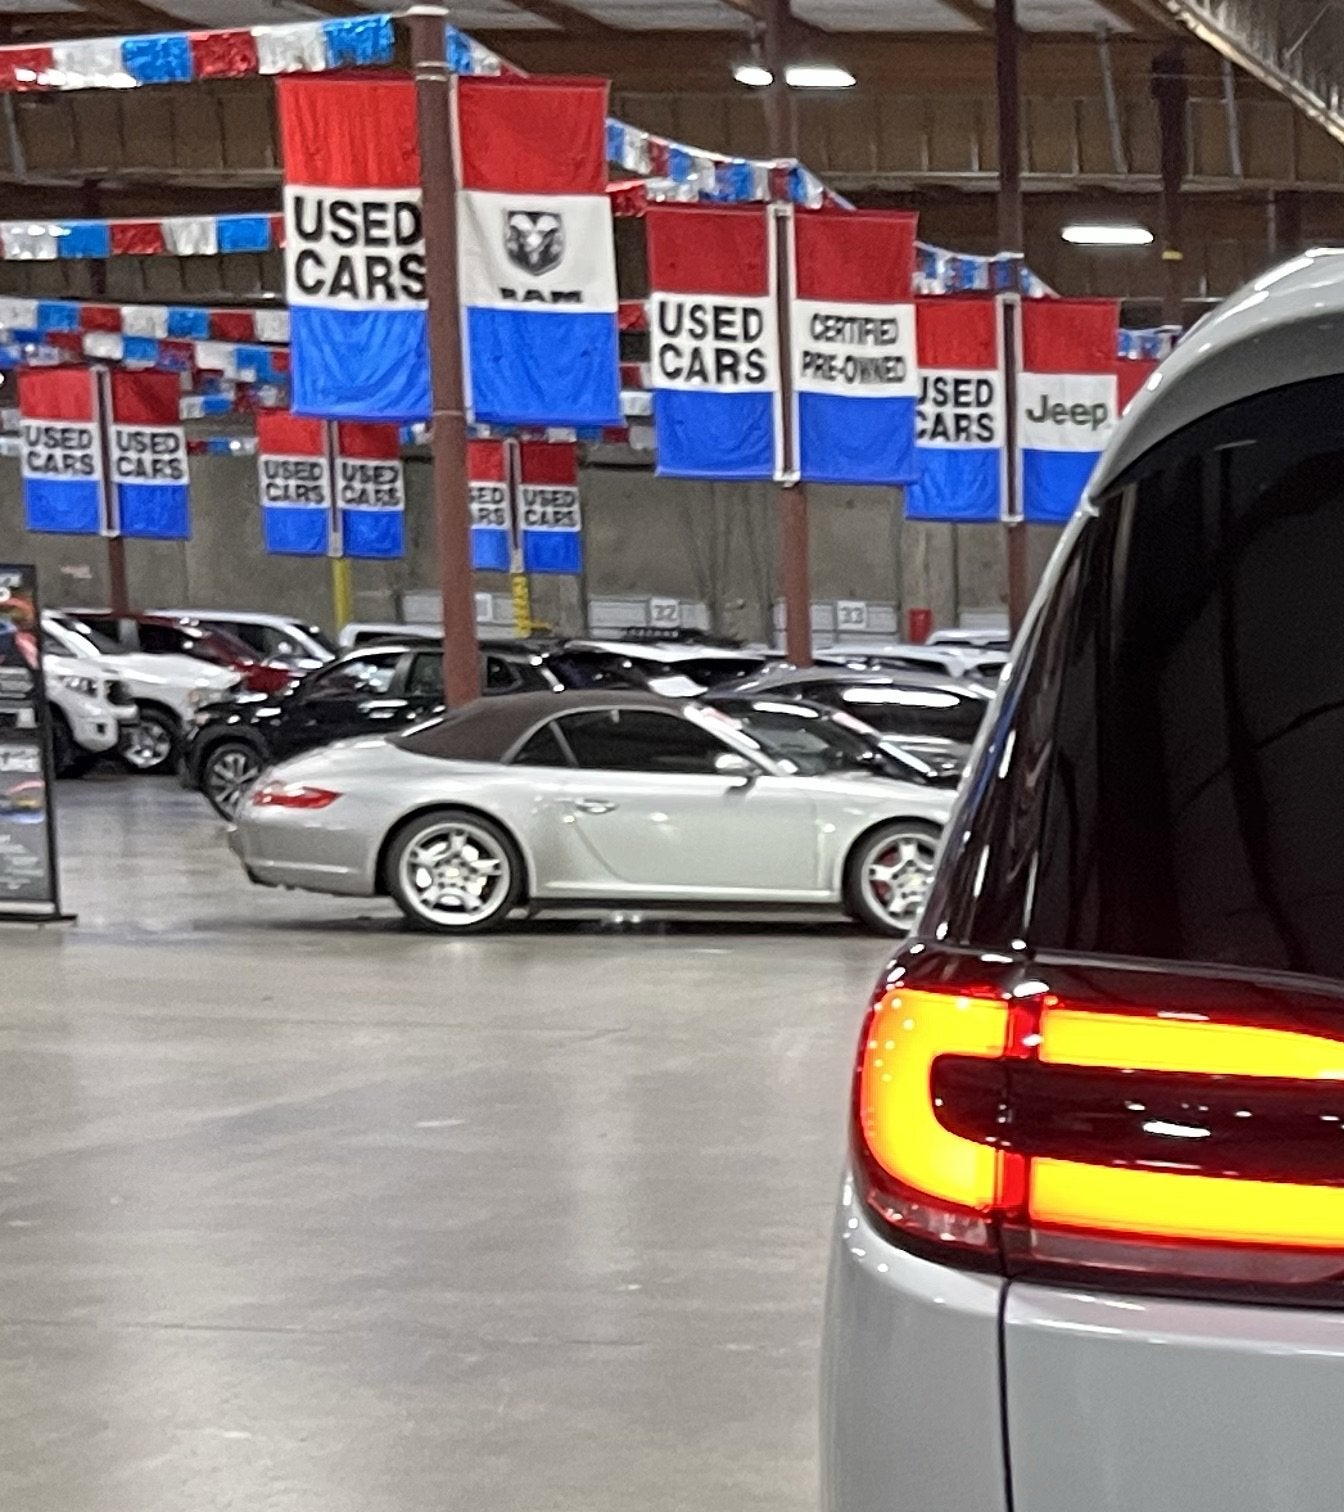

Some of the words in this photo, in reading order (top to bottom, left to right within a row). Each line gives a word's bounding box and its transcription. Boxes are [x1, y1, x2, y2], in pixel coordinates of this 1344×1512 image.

[294, 196, 422, 247] USED
[295, 249, 427, 300] CARS
[659, 301, 763, 343] USED
[810, 313, 898, 346] CERTIFIED
[659, 343, 767, 384] CARS
[801, 350, 907, 384] PRE-OWNED
[1026, 394, 1108, 431] Jeep
[25, 425, 93, 450] USED
[116, 430, 180, 454] USED
[27, 451, 95, 476] CARS
[117, 456, 184, 480] CARS
[264, 460, 323, 481] USED
[342, 462, 399, 484] USED
[266, 482, 325, 505] CARS
[342, 484, 400, 506] CARS
[523, 488, 575, 508] USED
